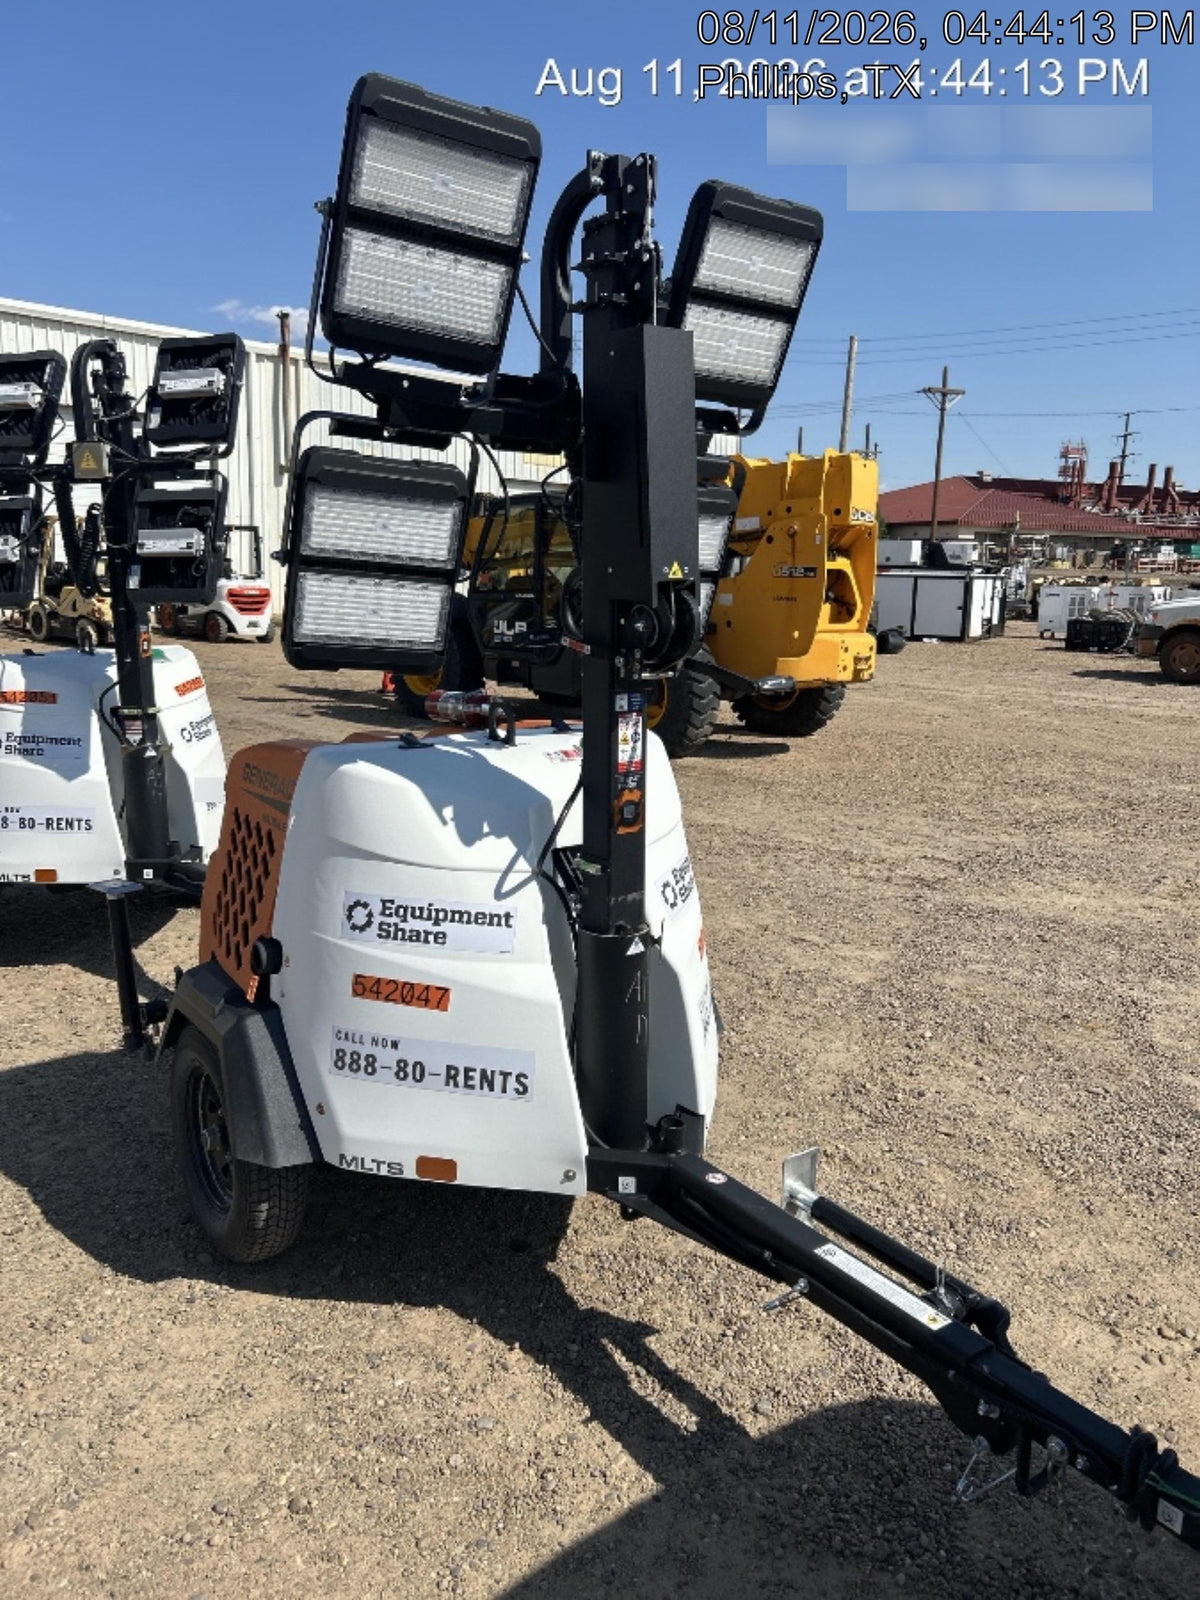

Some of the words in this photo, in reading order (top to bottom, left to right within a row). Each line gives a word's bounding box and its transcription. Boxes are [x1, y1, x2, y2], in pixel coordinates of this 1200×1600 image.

[4, 744, 44, 756] Share
[6, 732, 82, 747] Equipment
[378, 899, 514, 929] Equipment
[376, 920, 447, 946] Share
[353, 974, 450, 1009] 542047
[335, 1029, 365, 1046] CALL
[370, 1035, 401, 1051] NOW
[333, 1048, 529, 1097] 888-80-RENTS
[339, 1153, 404, 1175] MLTS
